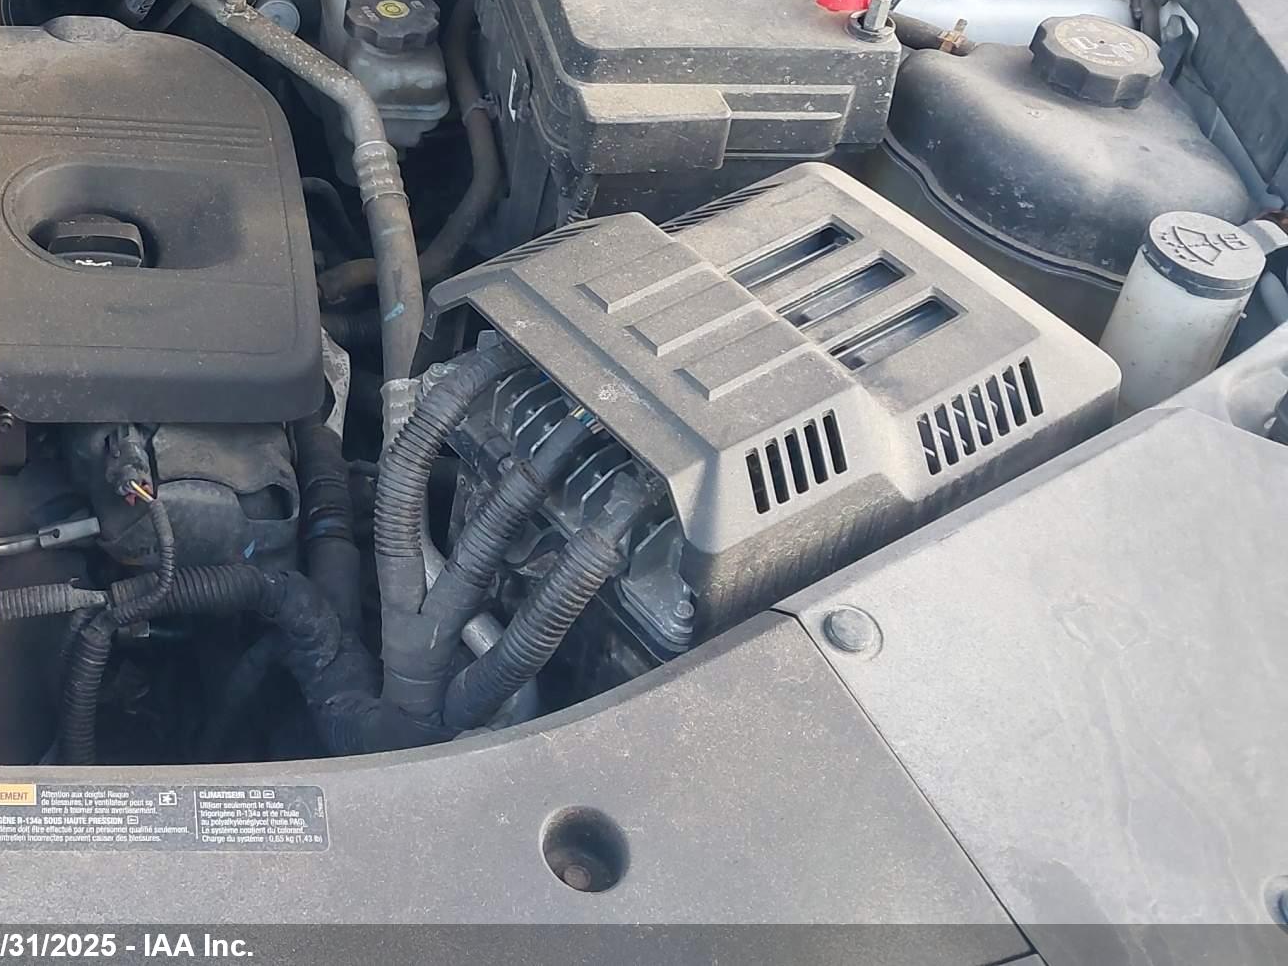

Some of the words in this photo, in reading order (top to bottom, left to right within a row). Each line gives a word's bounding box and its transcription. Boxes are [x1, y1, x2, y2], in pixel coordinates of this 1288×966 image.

[108, 791, 129, 799] Risque
[200, 802, 221, 810] Utiliser
[201, 811, 235, 819] frigorigène
[270, 819, 288, 827] (huile
[129, 826, 152, 834] qualifié
[211, 827, 238, 835] système
[202, 836, 225, 844] Charge
